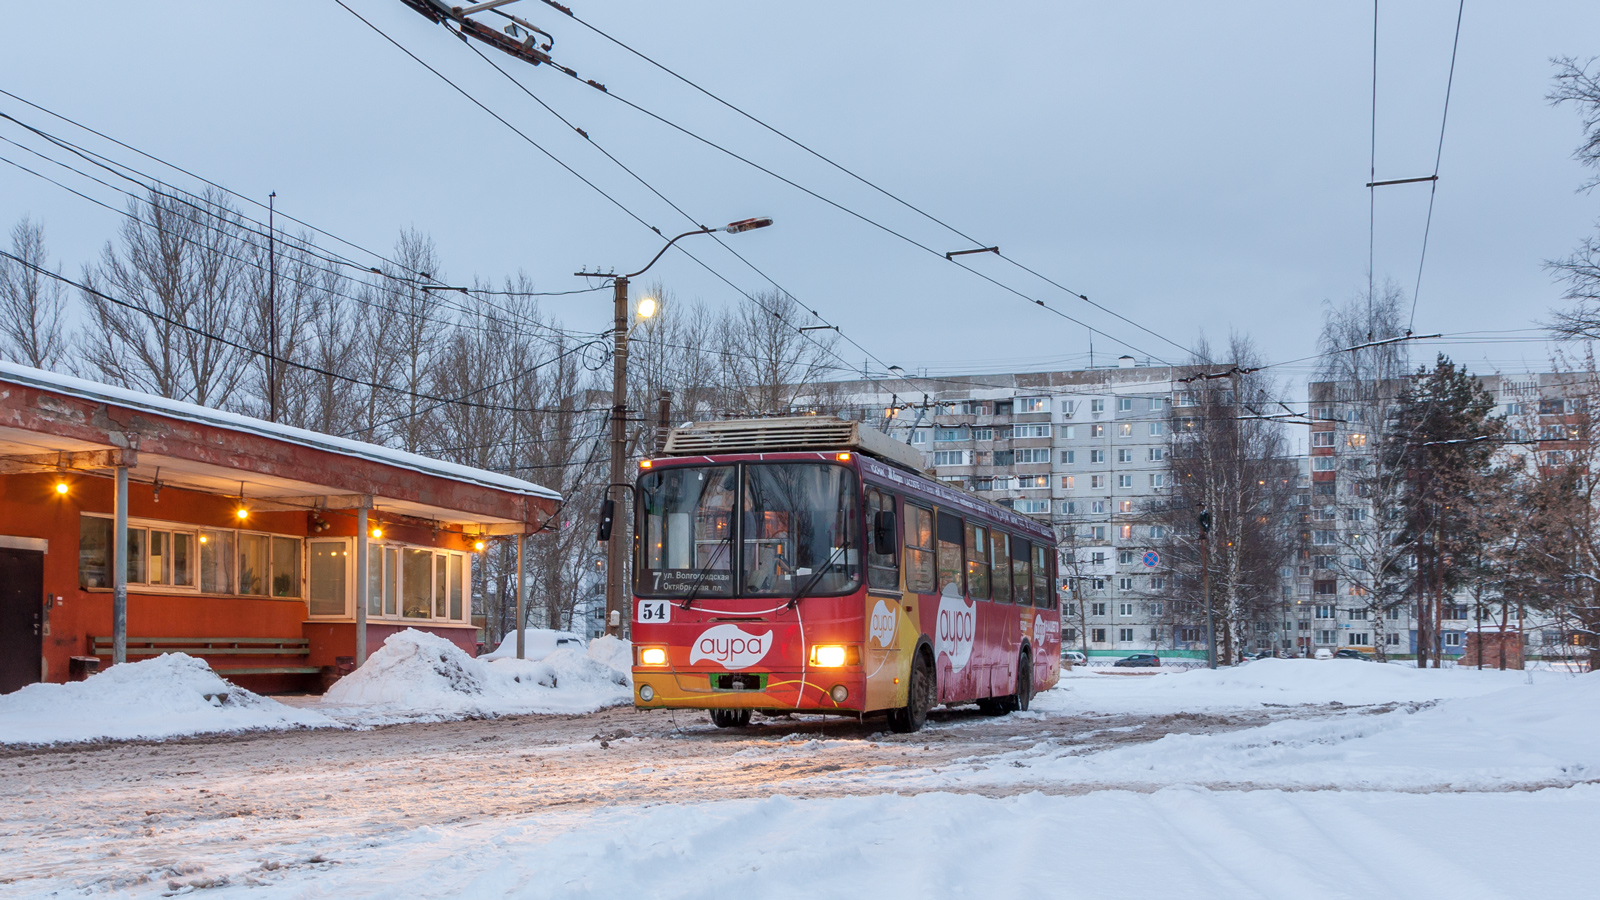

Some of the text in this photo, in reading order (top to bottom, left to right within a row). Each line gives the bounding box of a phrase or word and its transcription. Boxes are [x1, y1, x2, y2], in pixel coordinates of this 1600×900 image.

[652, 571, 662, 590] 7
[663, 572, 674, 580] ул.
[663, 582, 708, 592] Октябрьсая
[643, 603, 665, 619] 54
[873, 614, 892, 638] аура
[940, 609, 971, 656] аура
[700, 638, 761, 662] аура
